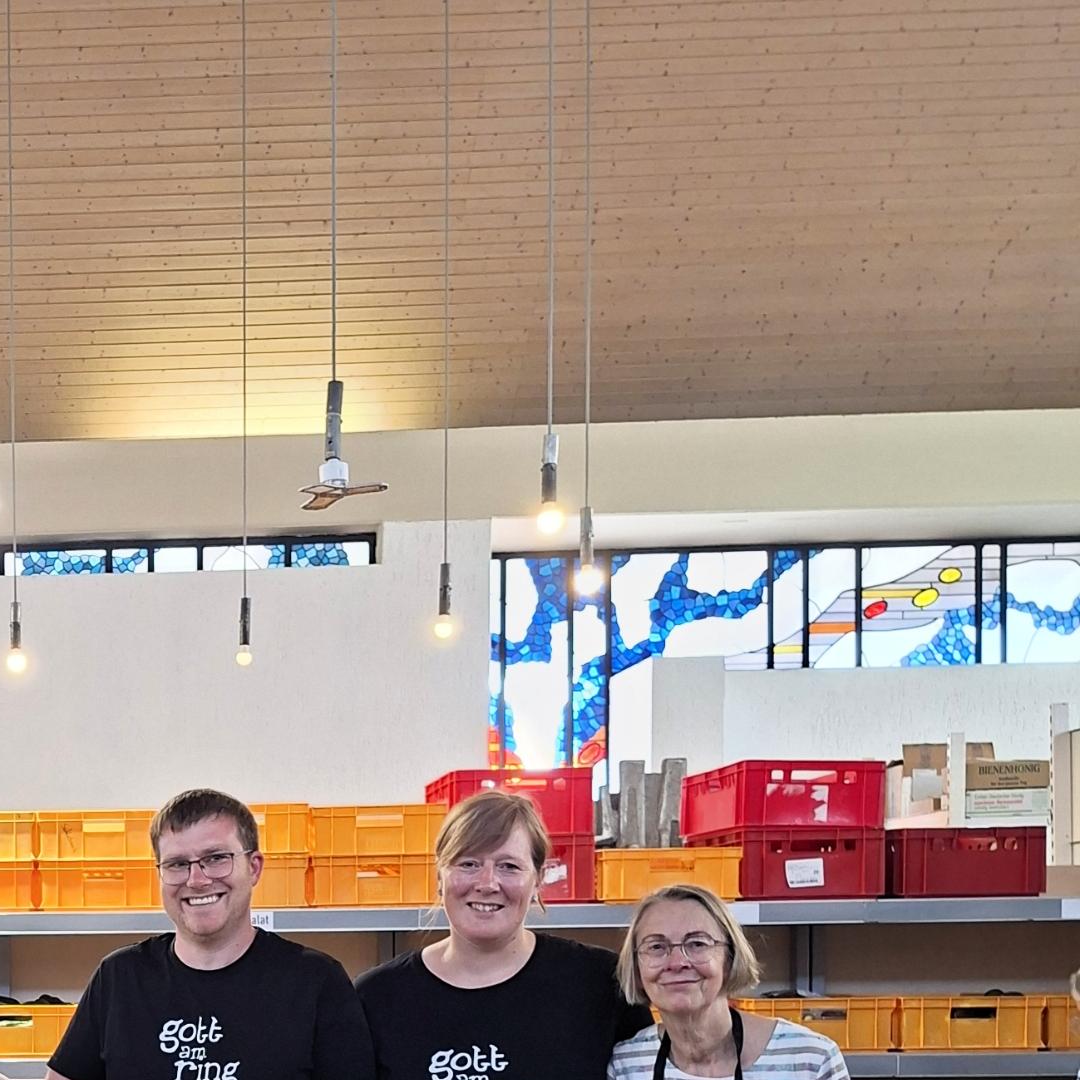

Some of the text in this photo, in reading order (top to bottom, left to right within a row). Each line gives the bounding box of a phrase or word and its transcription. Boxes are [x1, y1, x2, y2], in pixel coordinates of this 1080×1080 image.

[978, 763, 1041, 775] BIENENHONIG
[159, 1016, 224, 1053] gott
[179, 1045, 207, 1060] am
